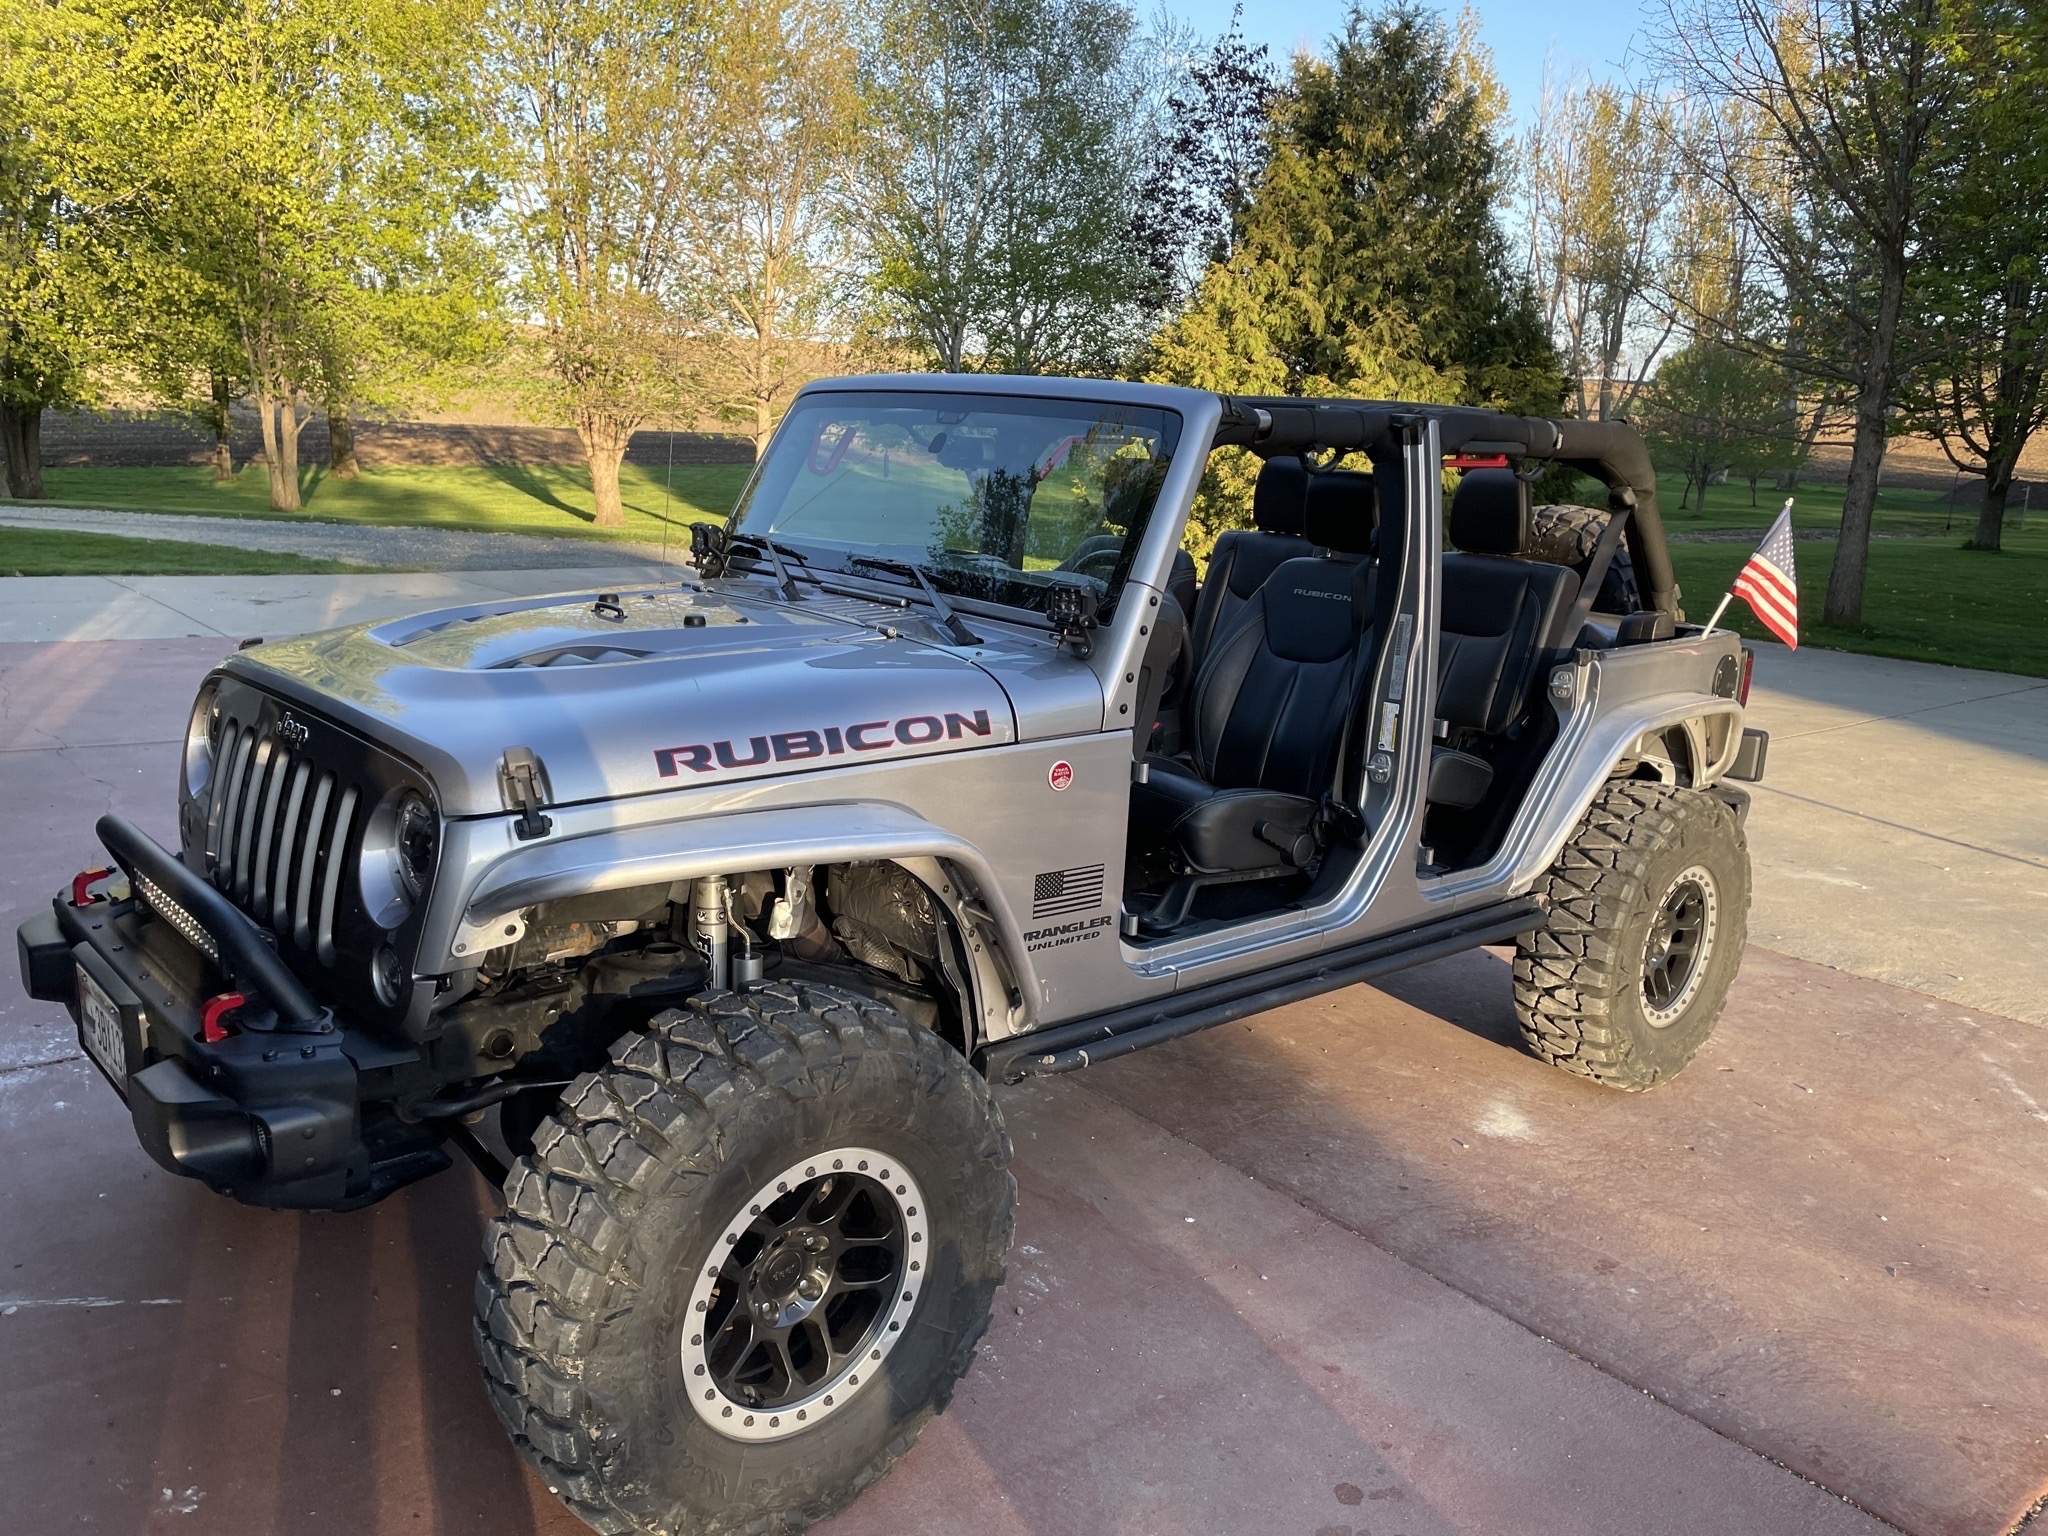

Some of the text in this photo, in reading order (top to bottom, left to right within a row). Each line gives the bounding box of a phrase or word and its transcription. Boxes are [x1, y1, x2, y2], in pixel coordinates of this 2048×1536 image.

[1293, 588, 1352, 602] RUBICON
[276, 711, 309, 751] Jeep
[653, 709, 992, 778] RUBICON
[1027, 931, 1101, 952] UNLIMITED
